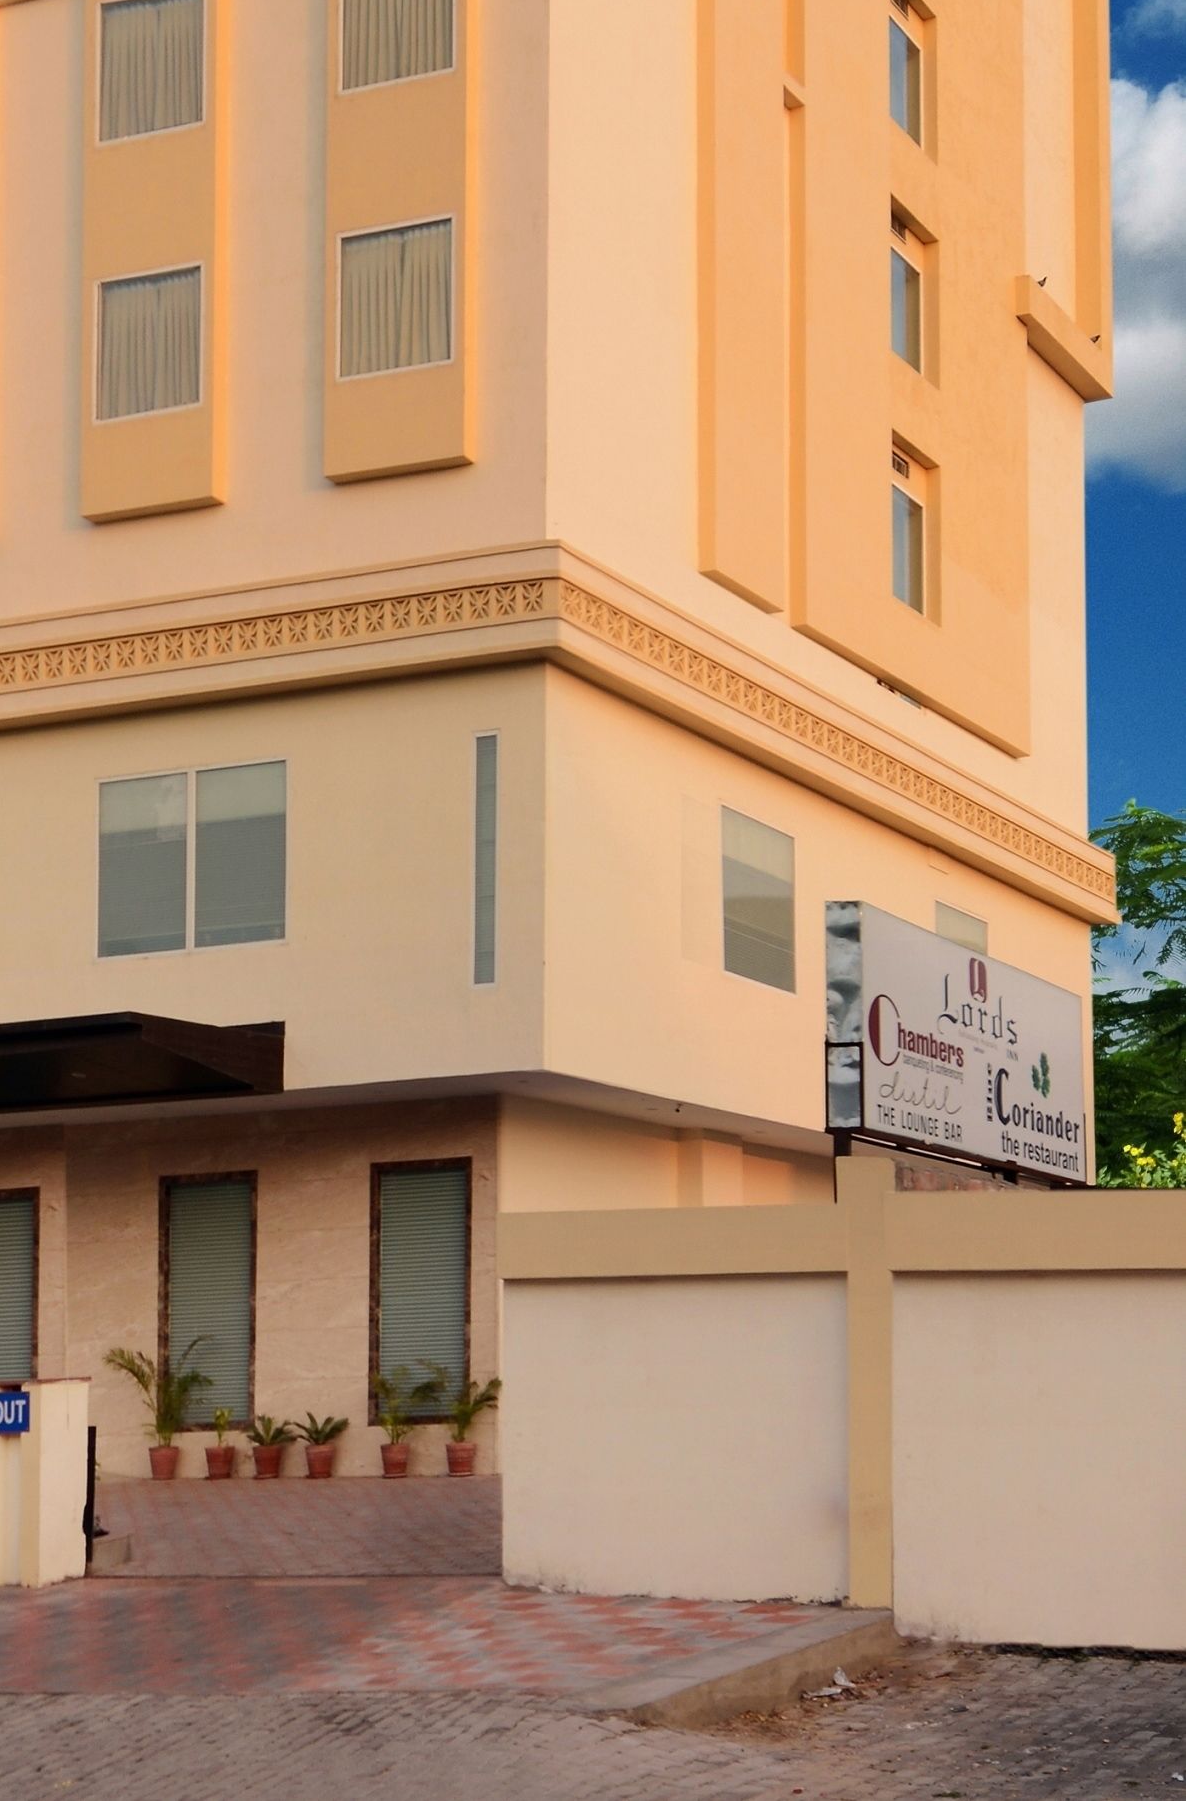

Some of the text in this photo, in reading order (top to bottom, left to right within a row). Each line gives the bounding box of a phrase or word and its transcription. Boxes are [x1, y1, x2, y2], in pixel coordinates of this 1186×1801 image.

[868, 994, 964, 1068] Chambers
[937, 973, 1018, 1045] Lords
[877, 1103, 963, 1143] THE LOUNGE BAR
[994, 1067, 1080, 1144] Coriander
[1001, 1130, 1079, 1173] the restaurant
